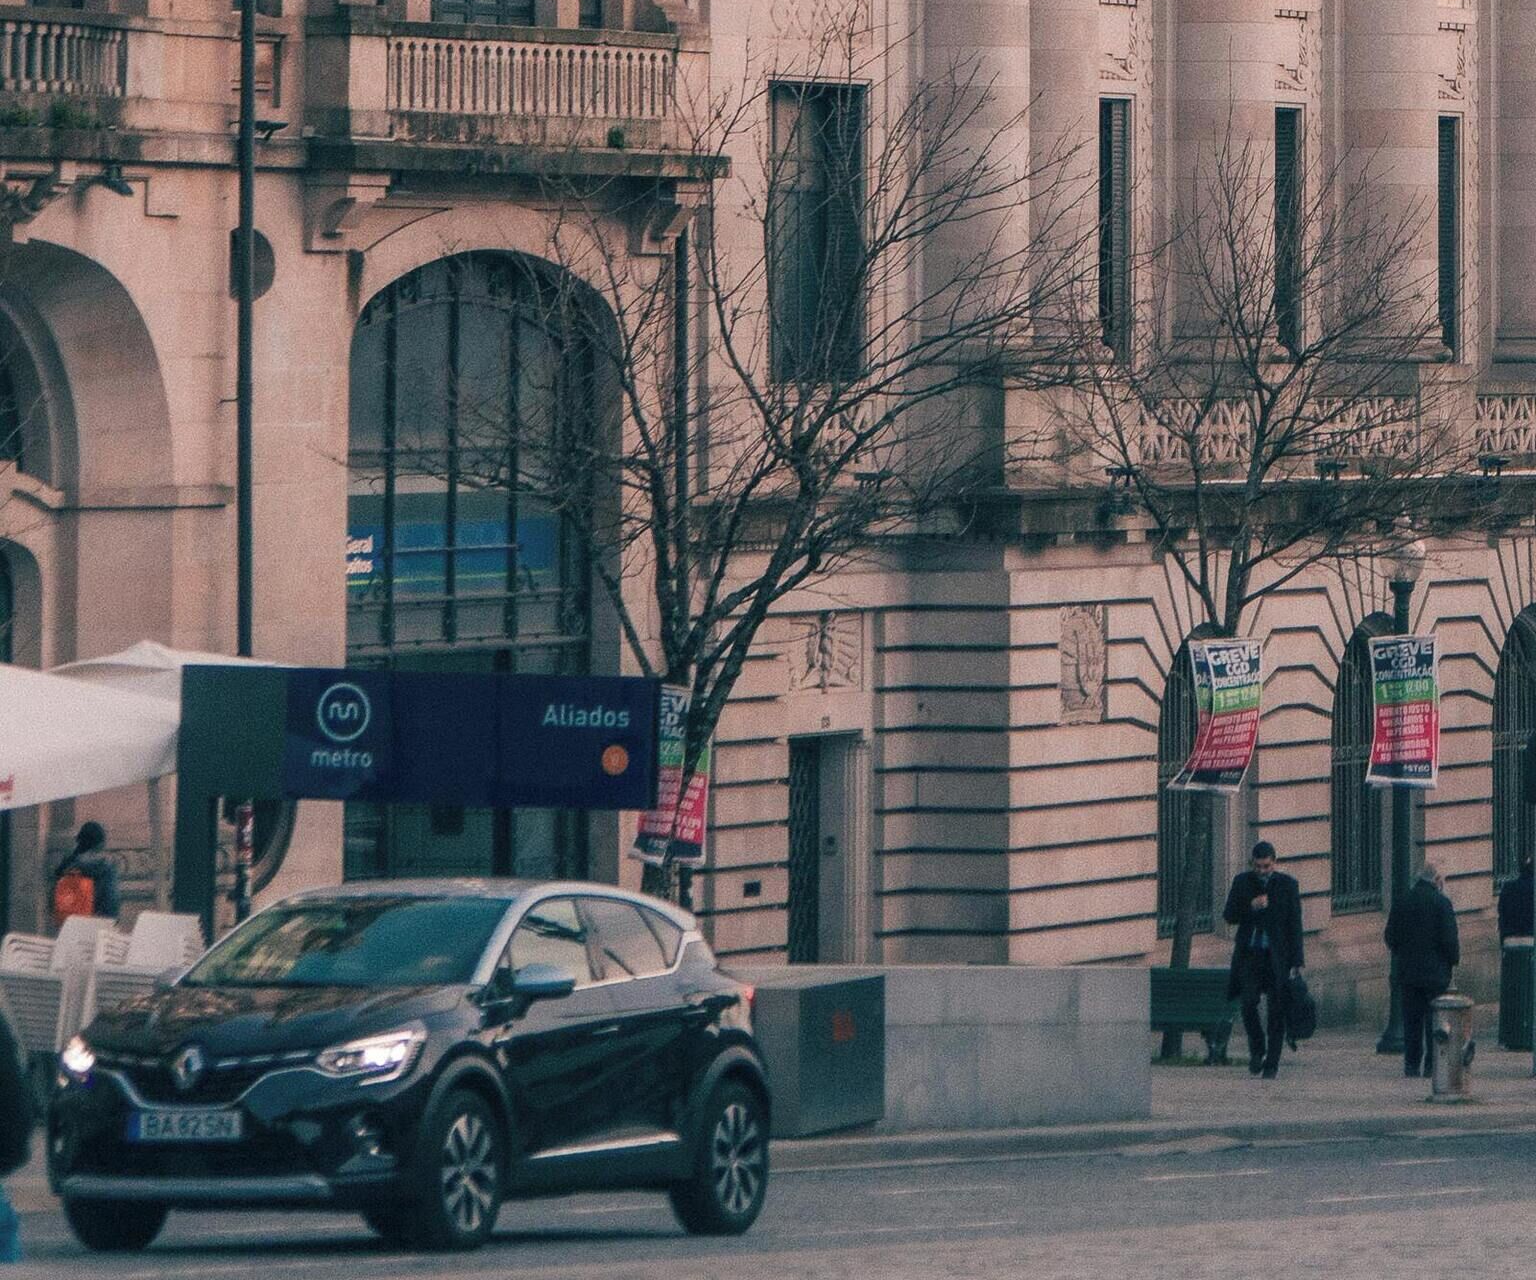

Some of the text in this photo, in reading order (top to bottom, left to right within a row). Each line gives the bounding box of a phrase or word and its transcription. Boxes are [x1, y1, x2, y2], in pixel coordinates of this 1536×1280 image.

[1208, 643, 1260, 667] GREVE
[1374, 641, 1433, 660] GREVE
[1225, 661, 1250, 676] CGD
[1390, 656, 1417, 670] CGD
[542, 704, 631, 729] Aliados
[311, 747, 373, 769] metro
